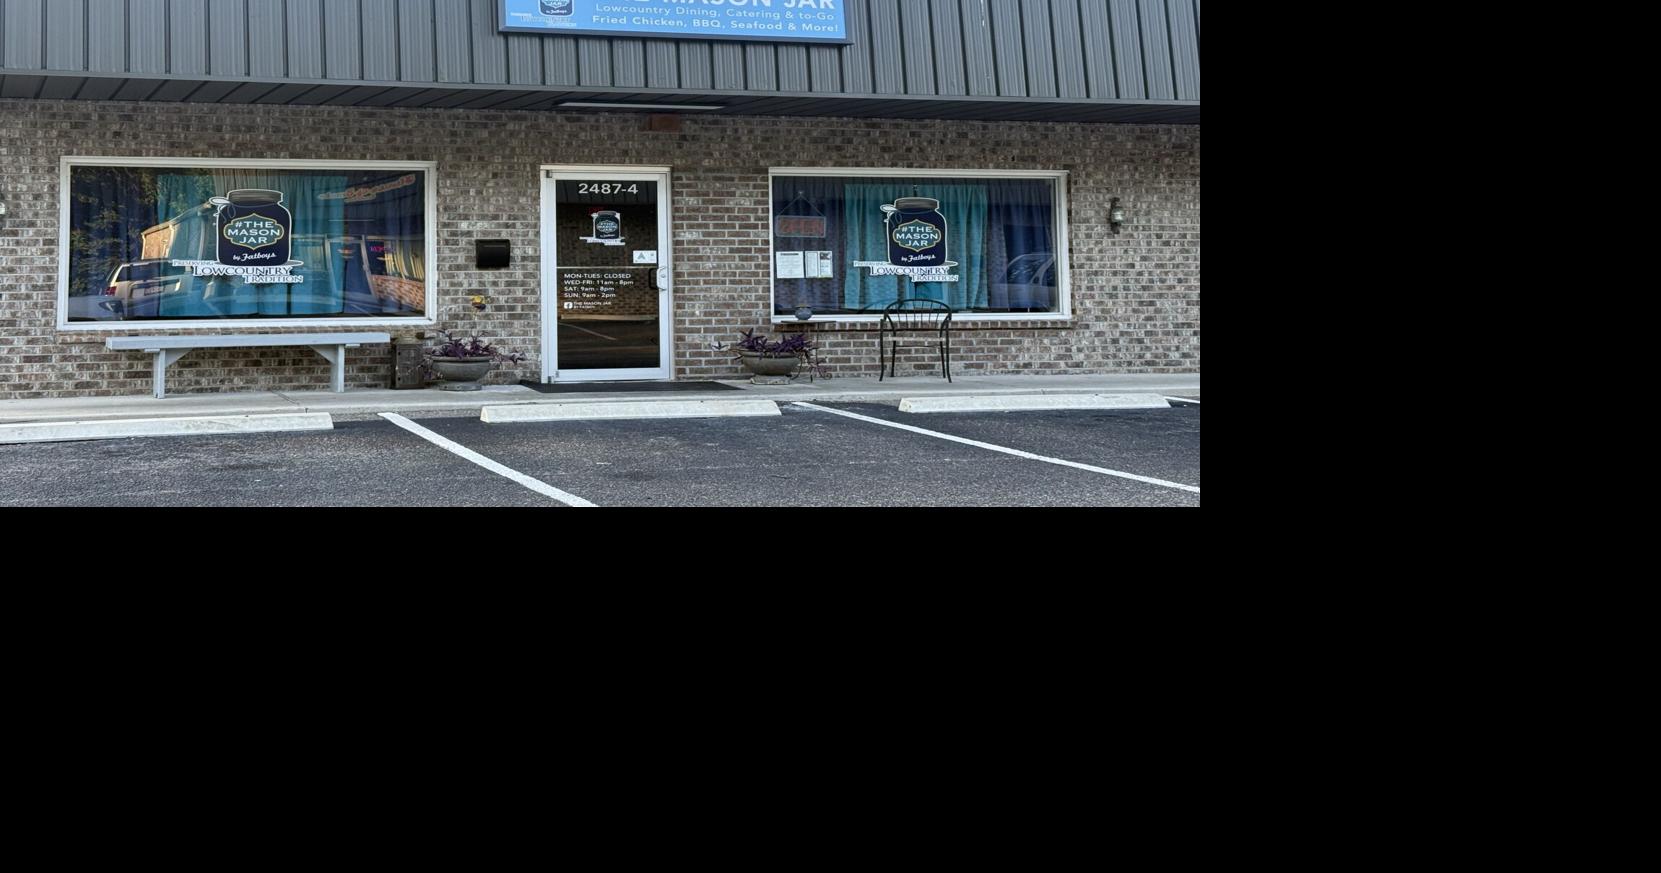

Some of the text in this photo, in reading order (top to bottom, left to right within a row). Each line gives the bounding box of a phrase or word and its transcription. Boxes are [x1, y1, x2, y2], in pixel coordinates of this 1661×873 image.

[595, 3, 671, 14] Lowcountry
[676, 6, 720, 17] Dining,
[726, 8, 780, 18] Catering
[785, 10, 793, 19] &
[799, 11, 834, 20] to-Go
[592, 15, 838, 32] Fried Chicken, BBQ, Seafood & More!
[578, 183, 639, 194] 2487-4
[239, 236, 268, 244] JAR
[240, 252, 278, 261] Fatboys
[907, 254, 936, 262] Fatboys
[193, 266, 292, 276] LOWCOUNTRY
[871, 266, 949, 275] LOWCOUNTRY
[245, 275, 303, 283] TRADITION
